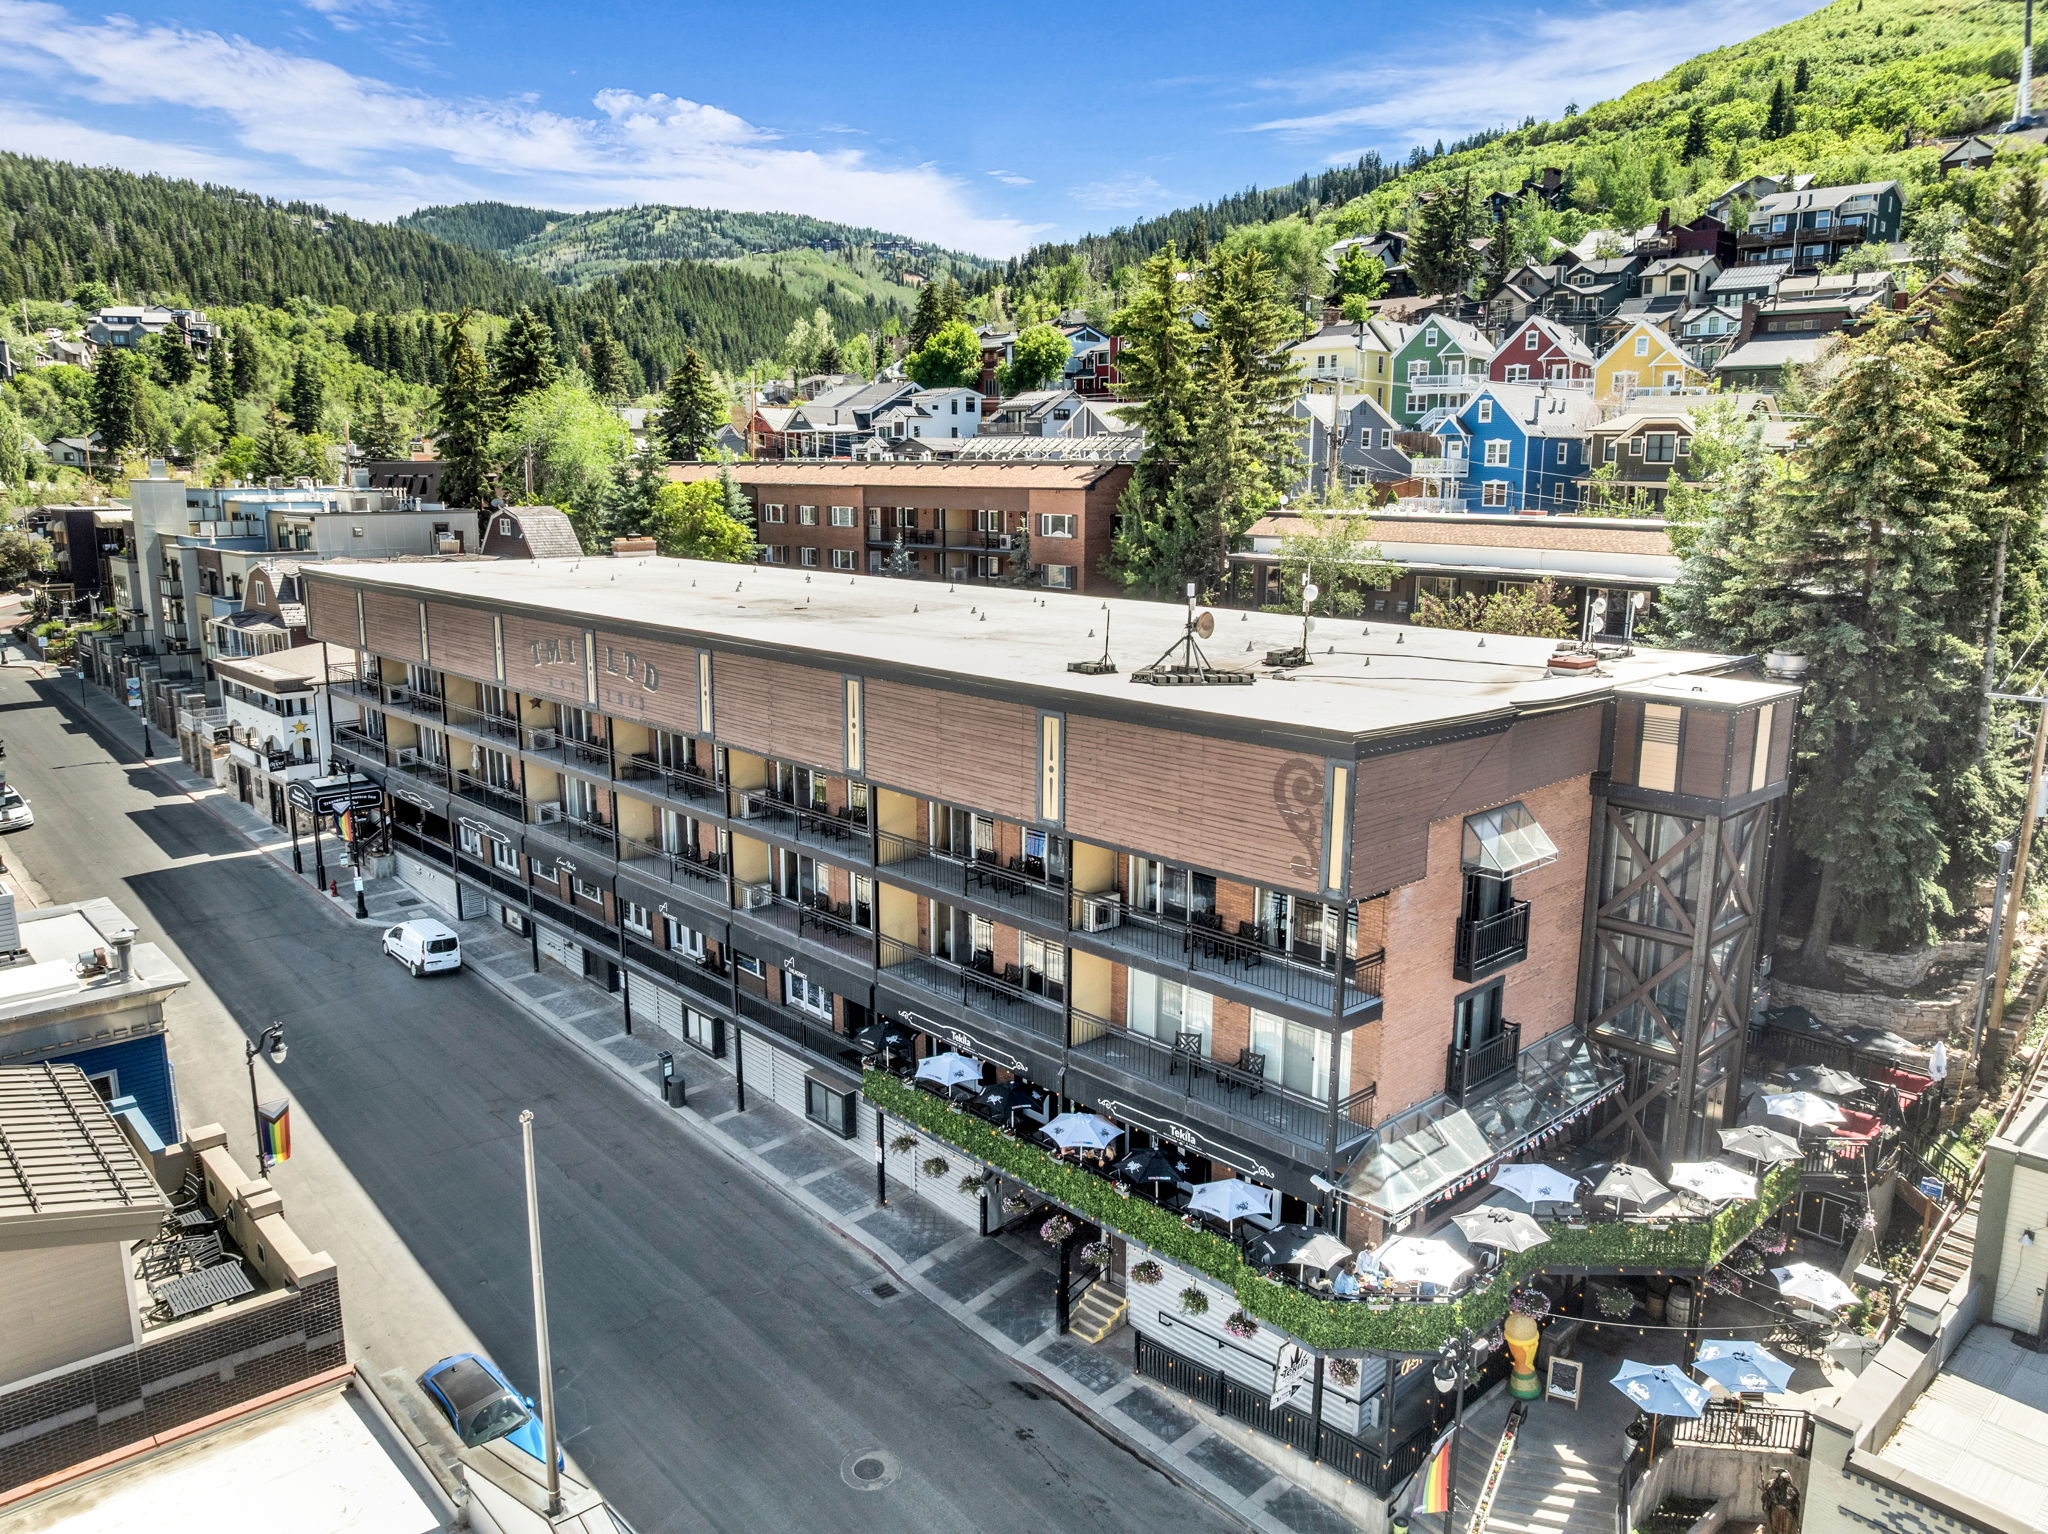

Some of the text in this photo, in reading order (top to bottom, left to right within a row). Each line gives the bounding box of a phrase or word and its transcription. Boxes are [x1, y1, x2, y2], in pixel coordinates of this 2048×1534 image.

[605, 646, 660, 694] LTD
[950, 1030, 971, 1047] Tekila
[1169, 1124, 1196, 1146] Tekila
